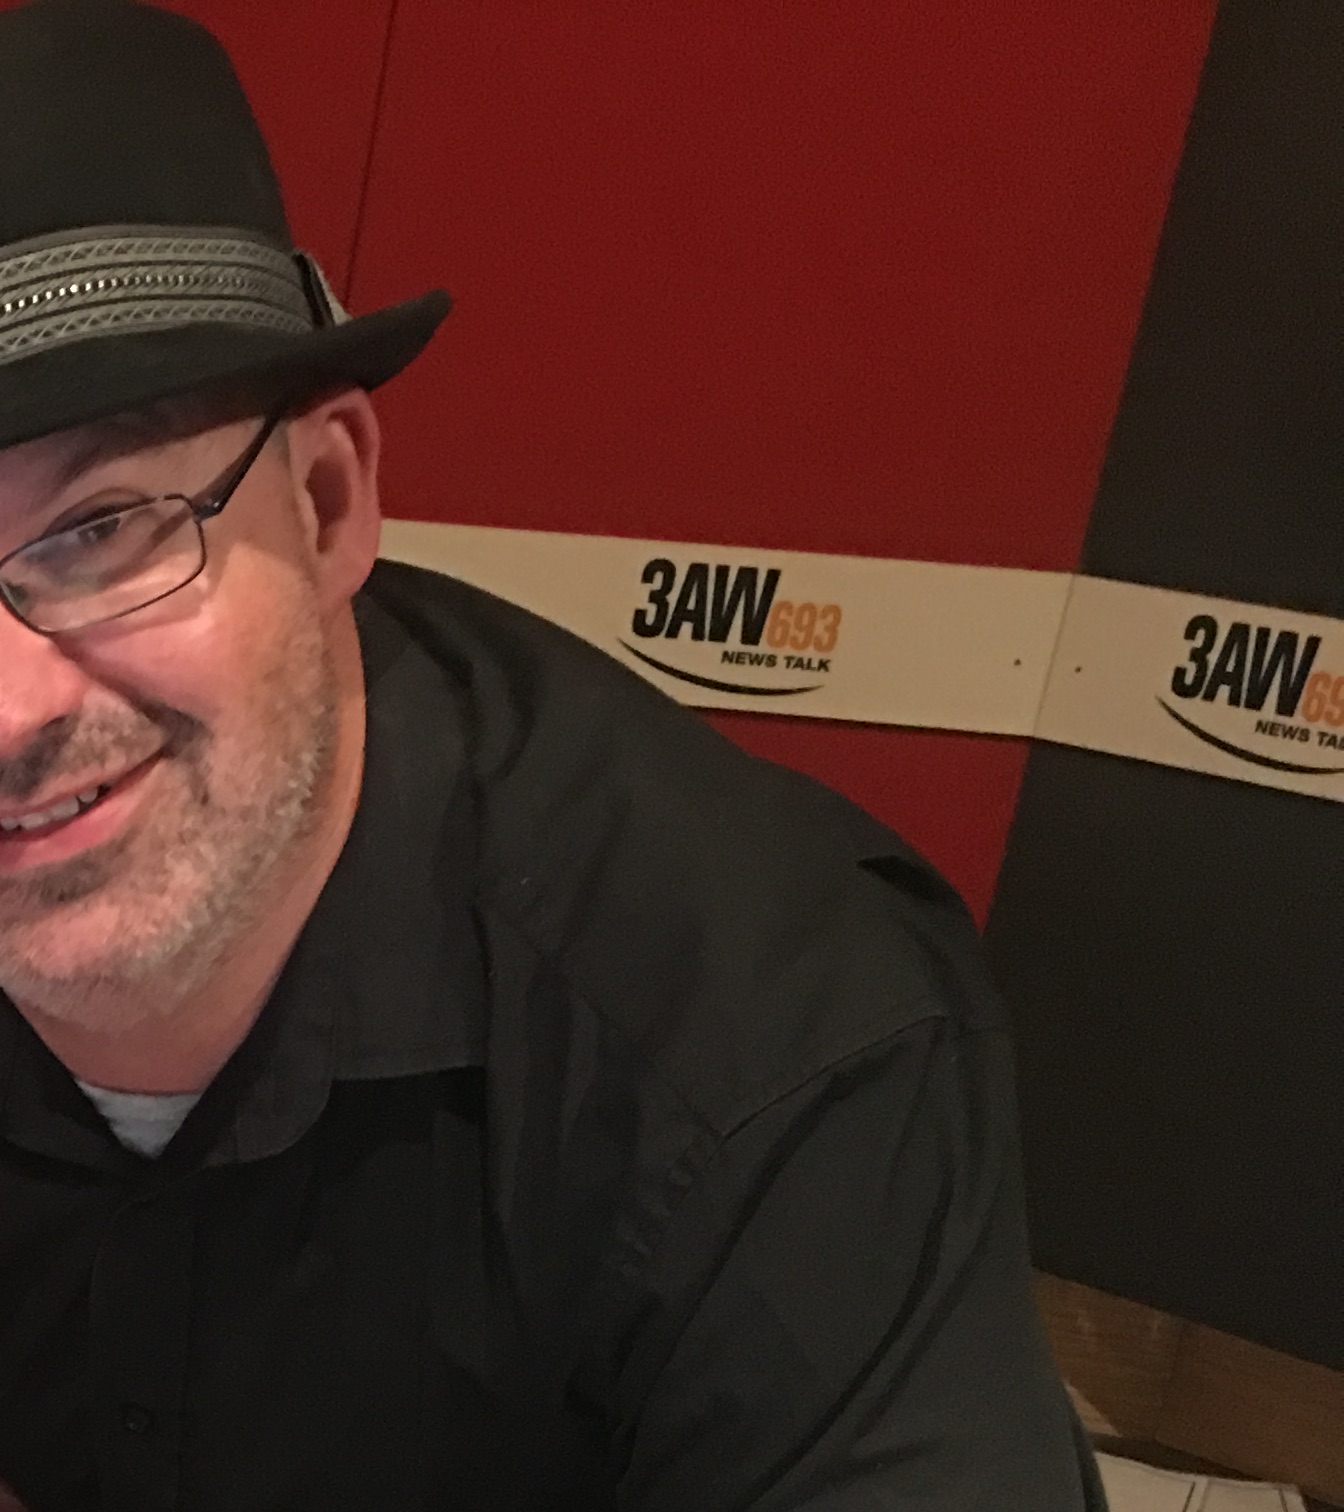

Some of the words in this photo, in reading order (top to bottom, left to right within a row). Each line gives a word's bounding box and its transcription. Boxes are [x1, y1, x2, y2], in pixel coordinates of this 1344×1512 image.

[721, 650, 778, 669] NEWS
[784, 654, 831, 673] TALK
[1254, 719, 1311, 743] NEWS
